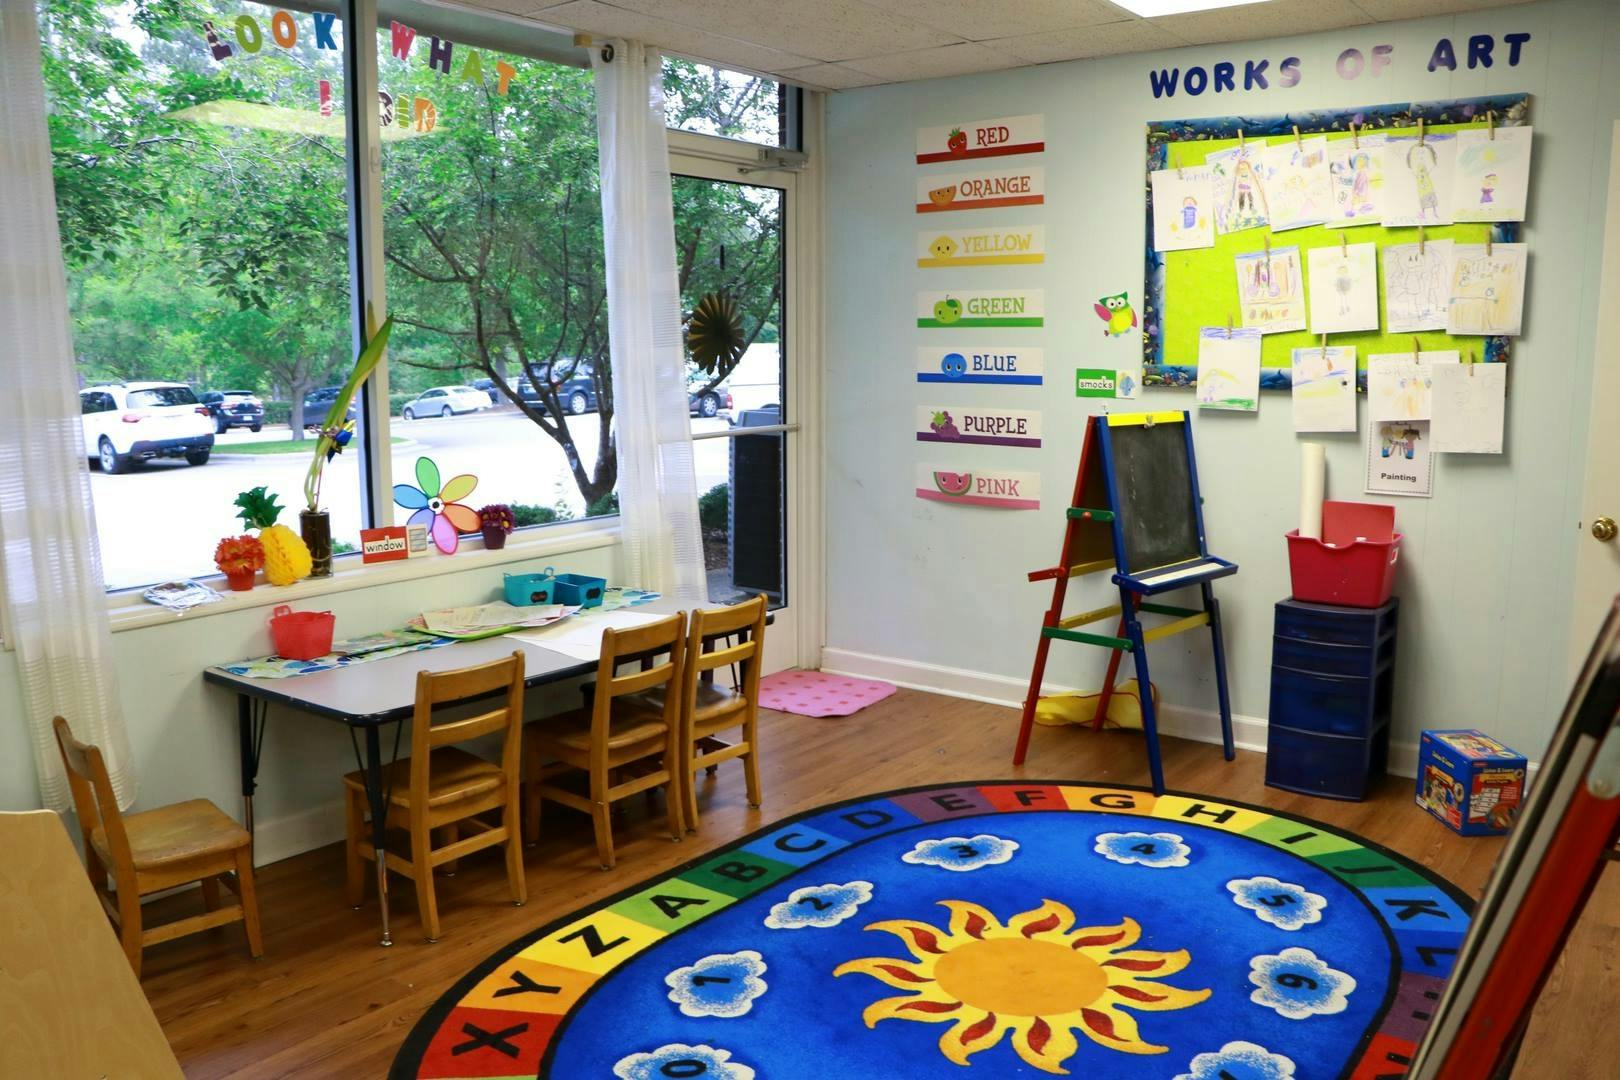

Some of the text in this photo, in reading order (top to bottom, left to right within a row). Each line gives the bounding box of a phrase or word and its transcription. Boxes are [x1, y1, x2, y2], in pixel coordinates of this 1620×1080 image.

[203, 11, 516, 96] LOOK WHAT
[1150, 32, 1531, 99] WORKS OF ART
[319, 80, 437, 132] I DID
[976, 126, 1009, 146] RED
[960, 176, 1031, 198] ORANGE
[962, 234, 1033, 253] YELLOW
[967, 297, 1025, 316] GREEN
[972, 354, 1017, 372] BLUE
[1080, 378, 1113, 389] smocks
[963, 415, 1027, 436] PURPLE
[976, 477, 1020, 496] PINK
[1380, 472, 1417, 483] Painting
[366, 538, 403, 552] window
[949, 844, 979, 859] 3
[1130, 842, 1158, 856] 4
[796, 896, 834, 911] 2
[1257, 894, 1297, 907] 5
[451, 1022, 530, 1059] X
[493, 970, 562, 998] Y
[557, 924, 631, 958] Z
[649, 894, 708, 919] A
[709, 860, 769, 884] B
[774, 832, 828, 853] C
[841, 810, 893, 829] D
[928, 793, 978, 812] E
[1013, 790, 1046, 807] F
[1089, 793, 1136, 809] G
[1182, 803, 1237, 824] H
[1332, 864, 1400, 876] J
[1384, 899, 1451, 921] K
[692, 975, 731, 987] 1
